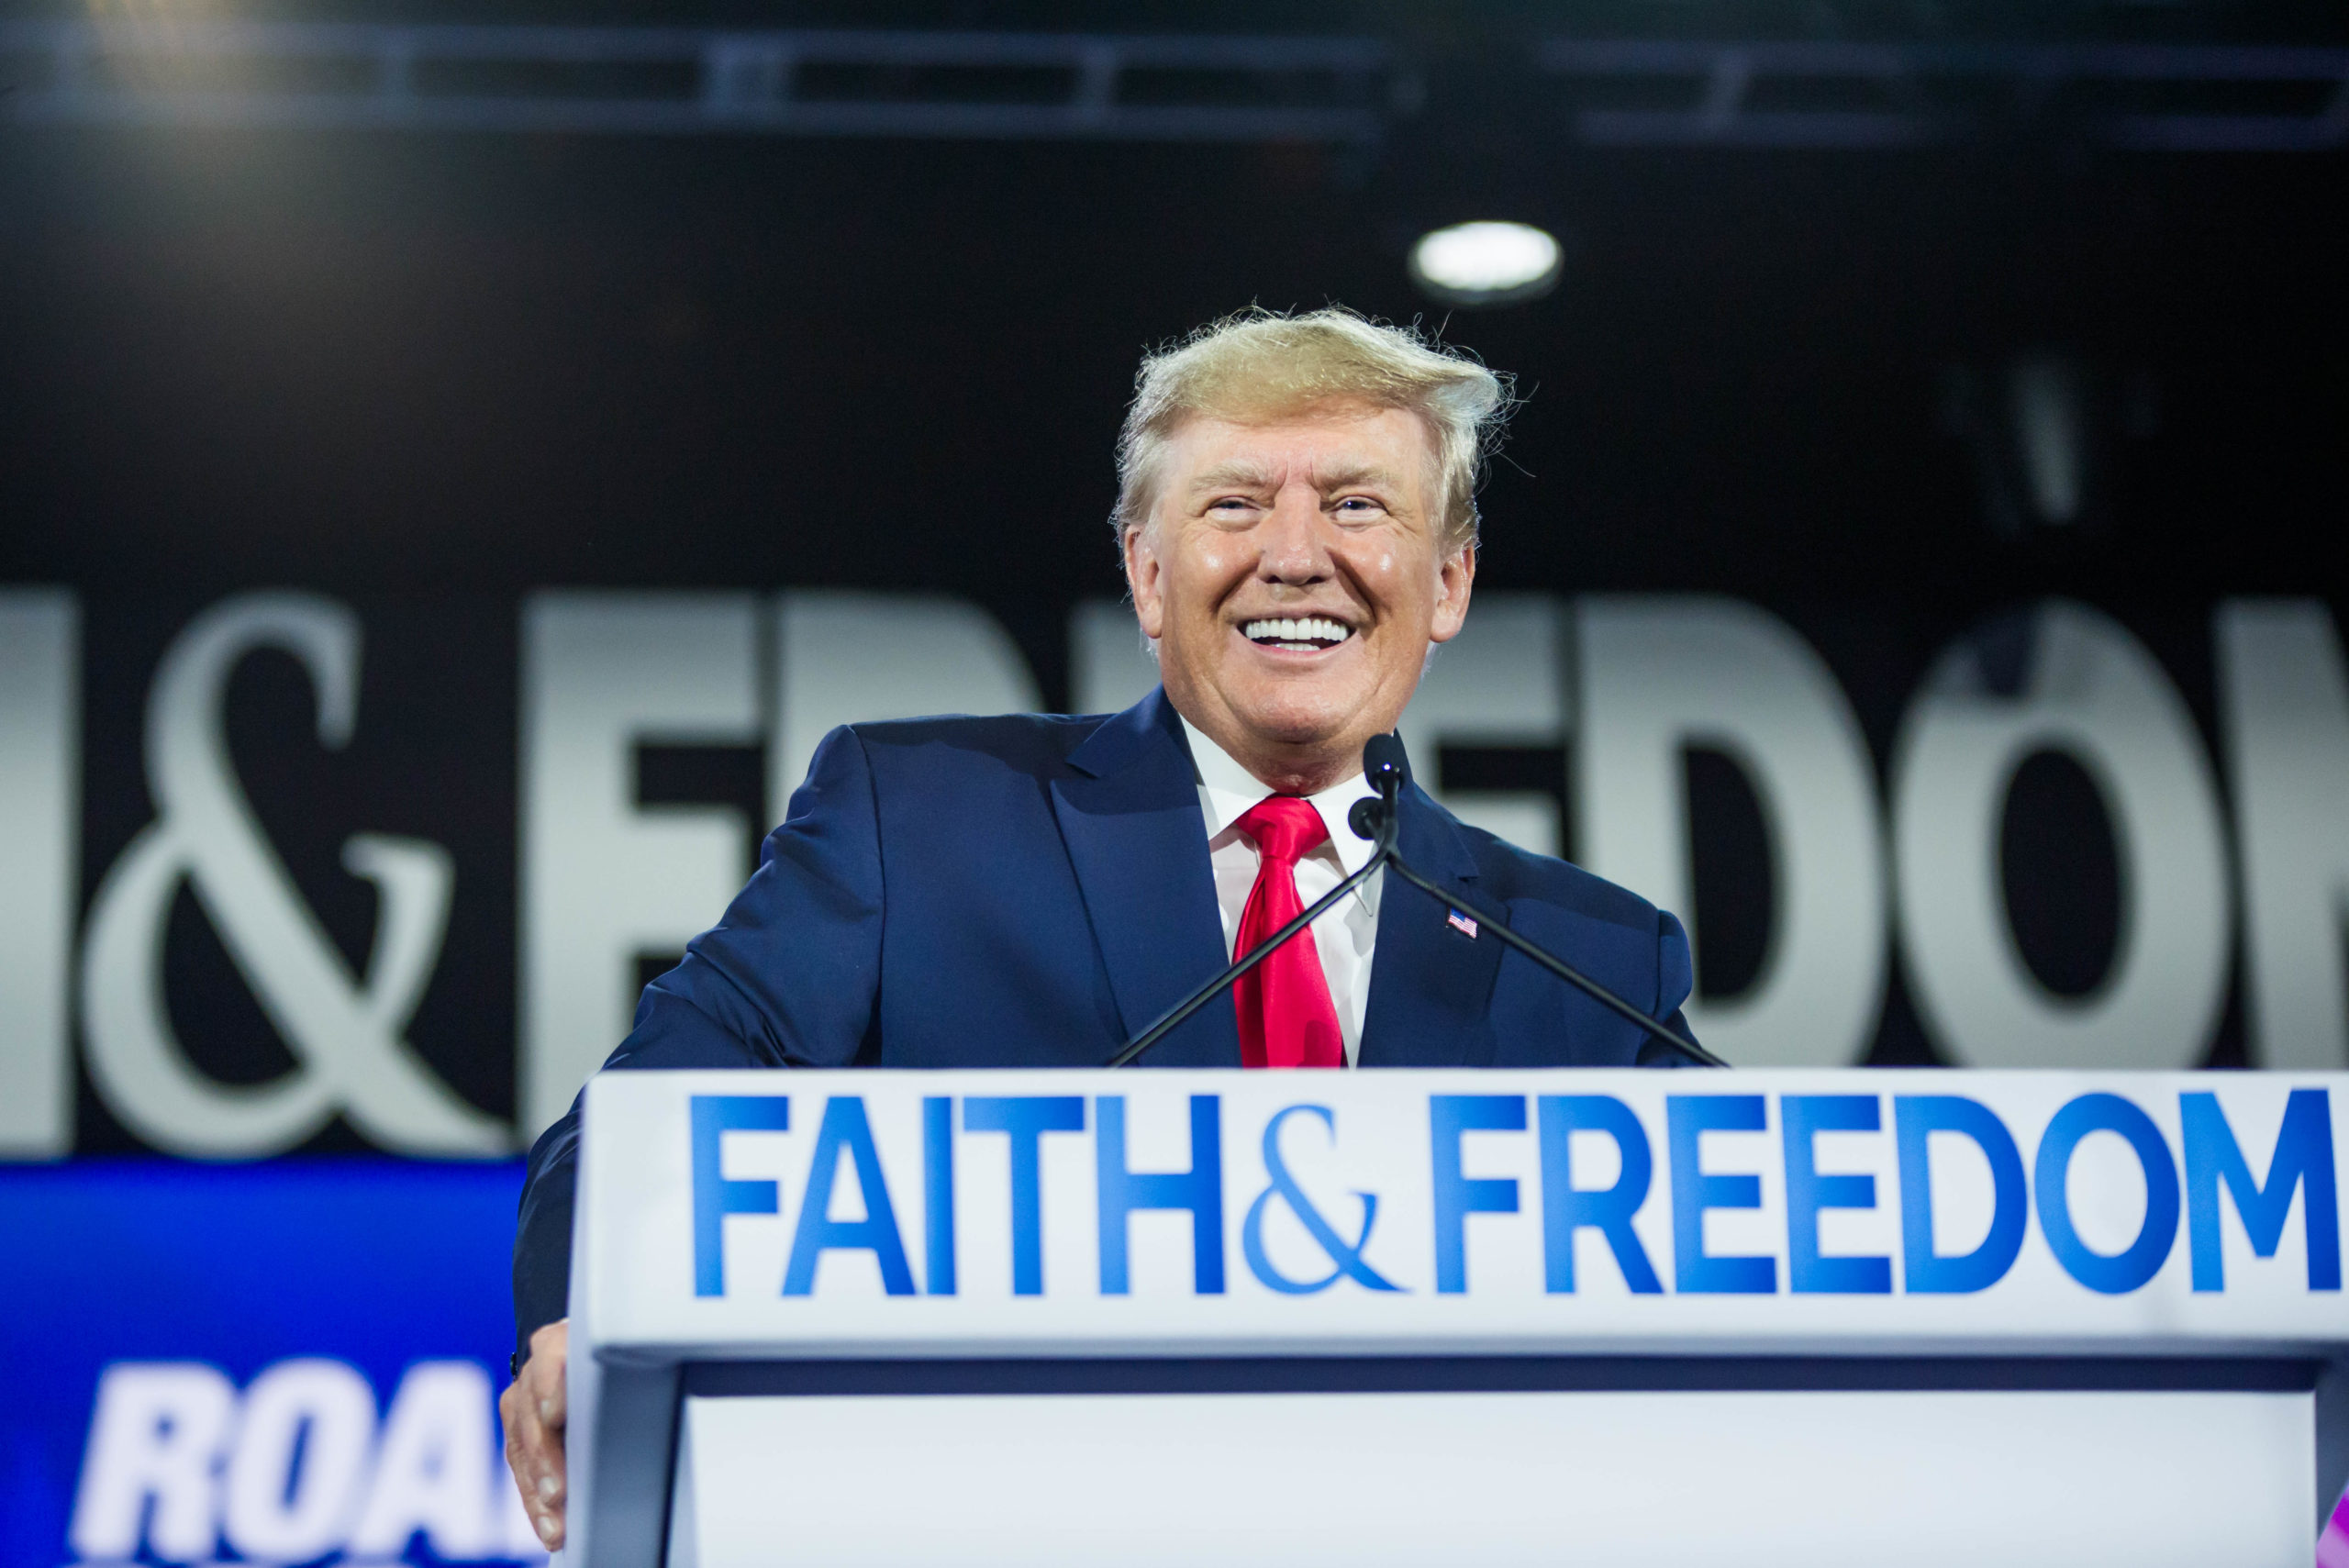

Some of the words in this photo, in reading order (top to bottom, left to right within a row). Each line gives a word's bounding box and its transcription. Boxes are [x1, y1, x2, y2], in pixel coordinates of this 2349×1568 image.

[81, 593, 514, 1160] &
[688, 1094, 1228, 1297] FAITH
[1241, 1103, 1413, 1296] &
[1428, 1087, 2343, 1296] FREEDOM
[72, 1360, 545, 1562] ROA
